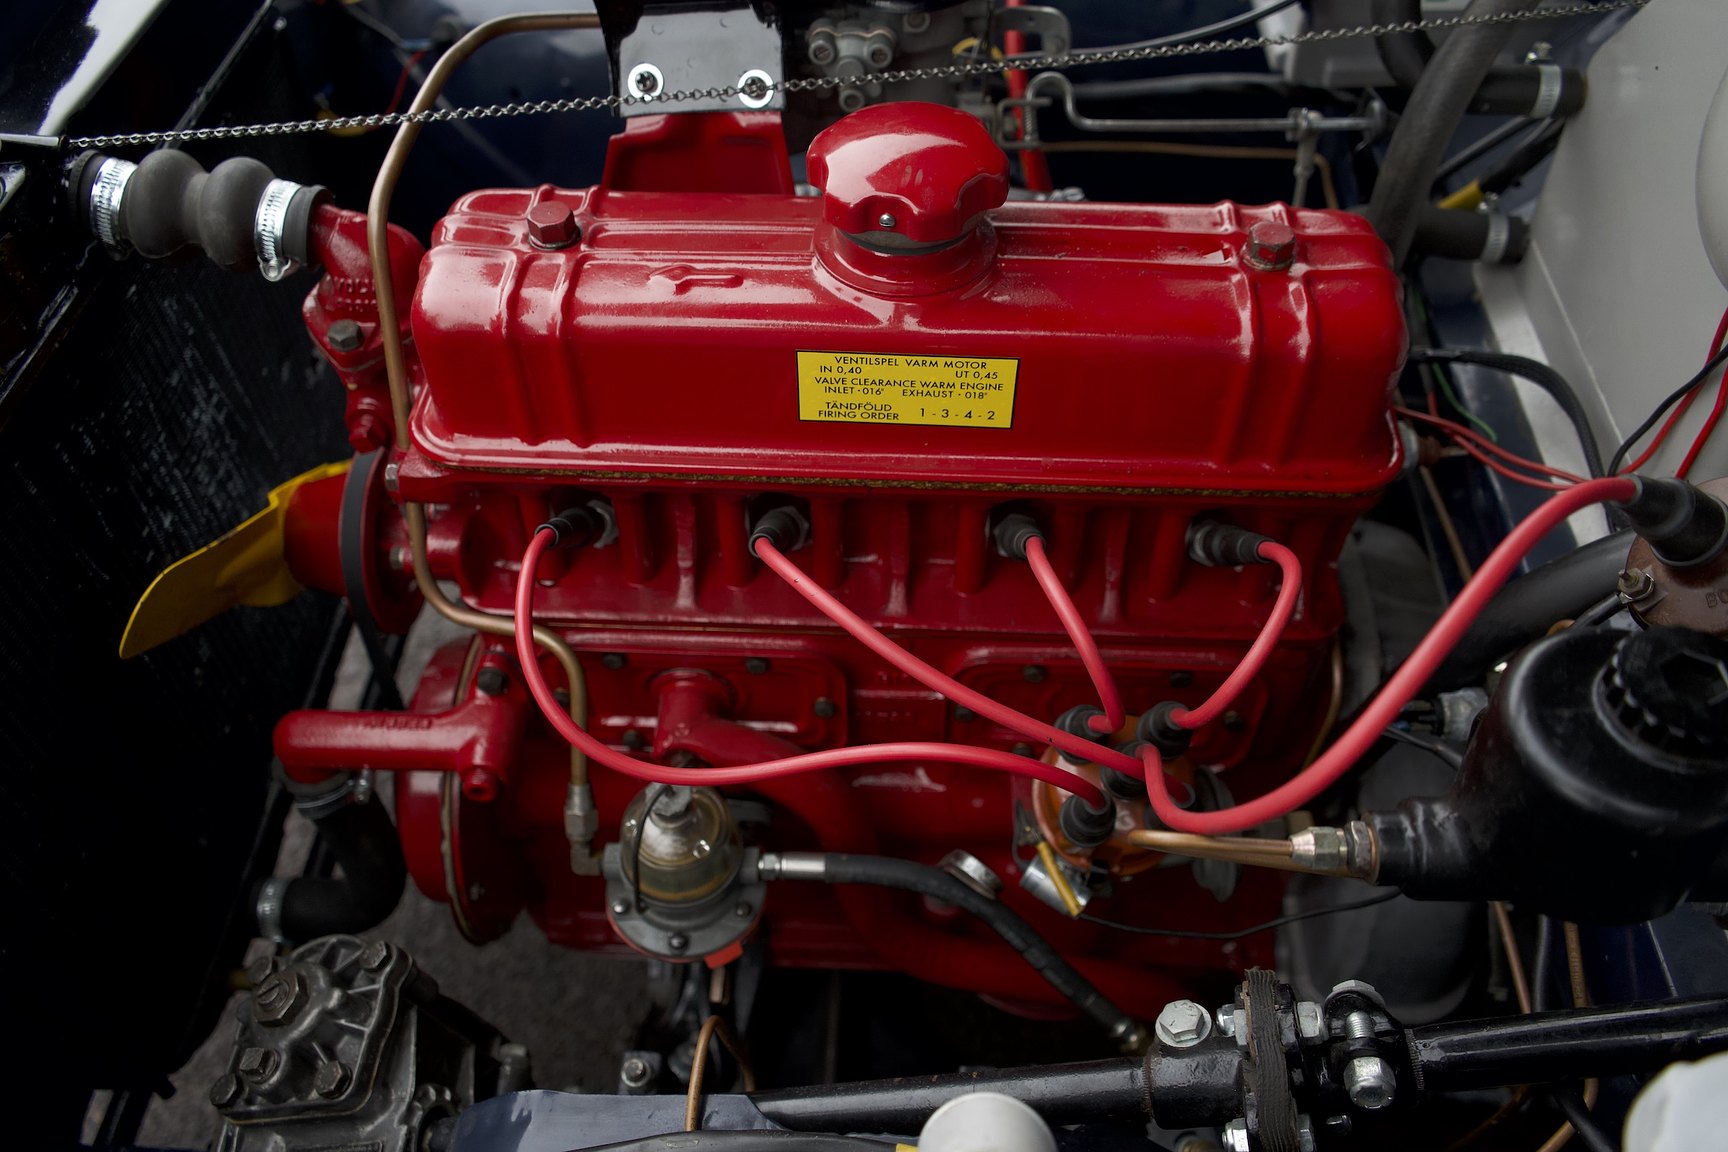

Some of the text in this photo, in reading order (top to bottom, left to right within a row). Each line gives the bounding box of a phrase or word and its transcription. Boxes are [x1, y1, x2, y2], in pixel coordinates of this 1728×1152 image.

[834, 356, 987, 370] VENTILSPEL VARM MOTOR
[820, 365, 862, 375] IN 0,40
[955, 370, 998, 380] UT 0,45
[814, 376, 1004, 391] VALVE CLEARANCE WARM ENGINE
[824, 386, 855, 394] INLET
[902, 389, 954, 398] EXHAUST
[818, 410, 899, 420] FIRING ORDER
[941, 408, 949, 418] 3
[964, 410, 972, 419] 4
[987, 410, 995, 420] 2
